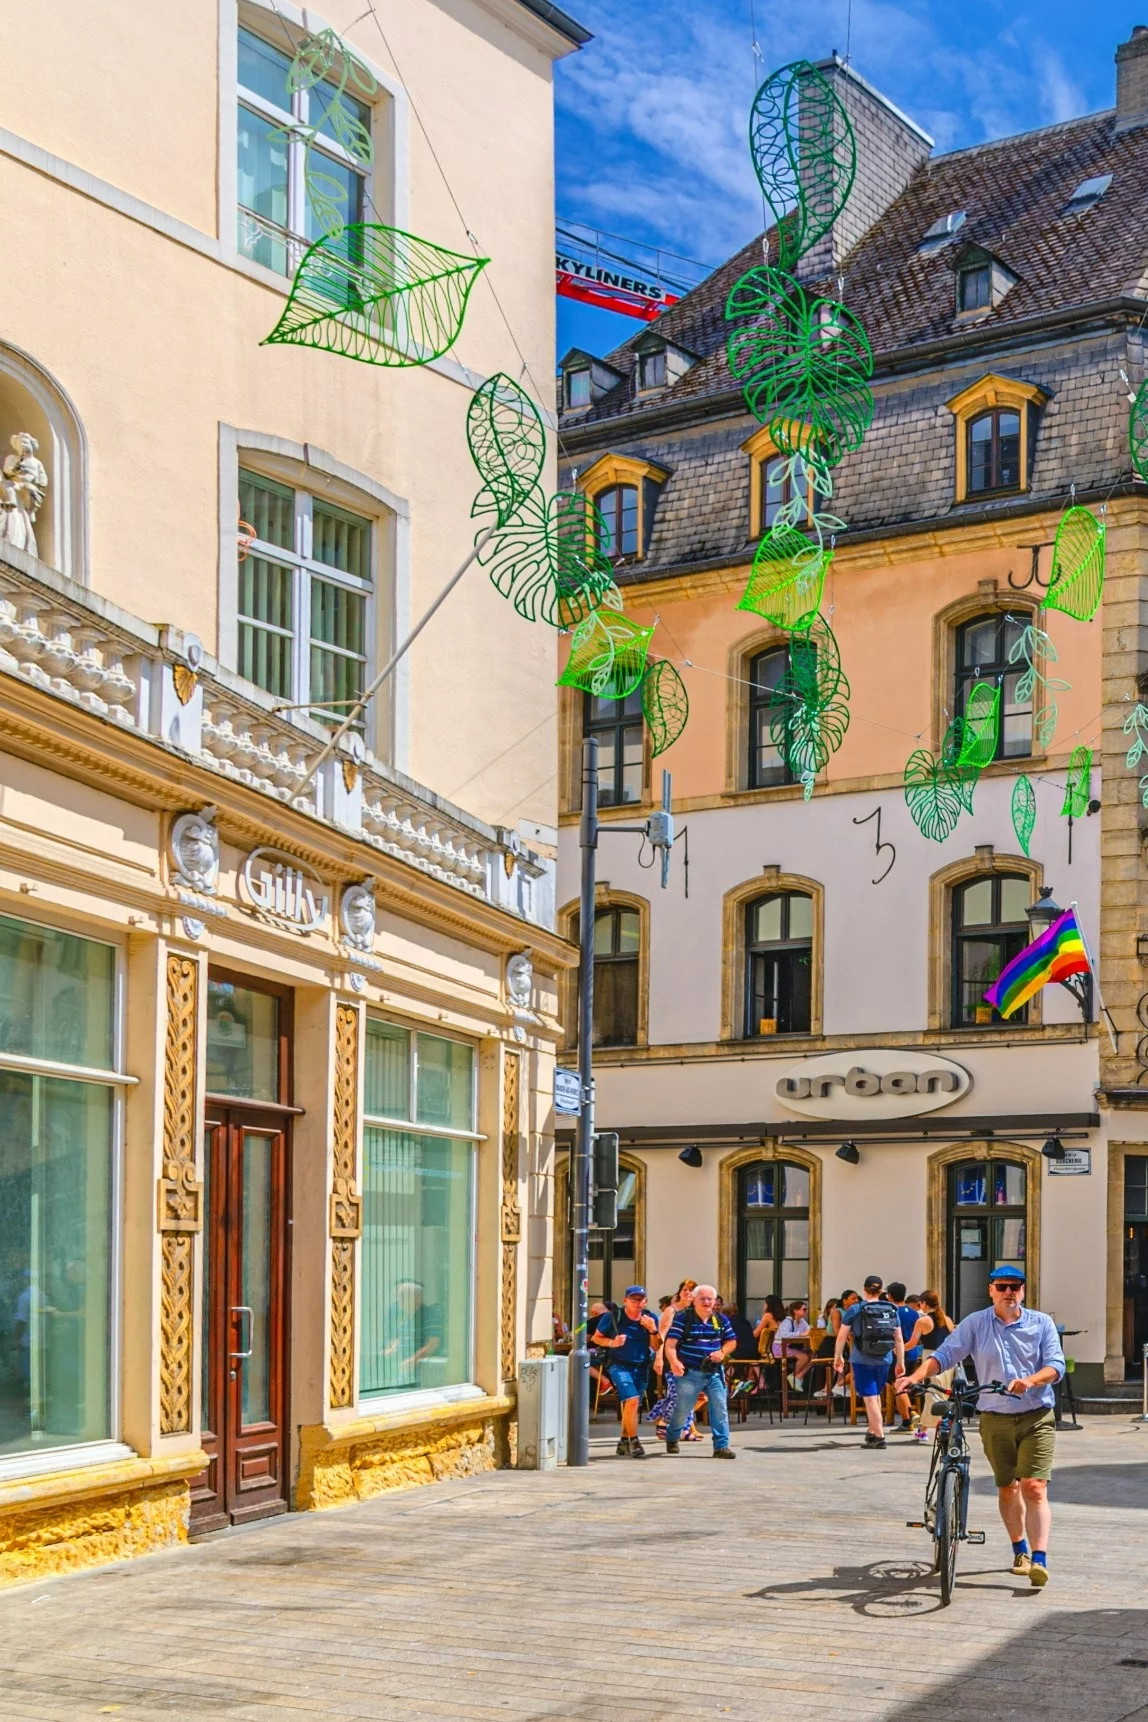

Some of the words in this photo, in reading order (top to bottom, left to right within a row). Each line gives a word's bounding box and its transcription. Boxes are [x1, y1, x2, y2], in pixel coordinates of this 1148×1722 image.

[556, 256, 662, 299] KYLINERS
[245, 846, 328, 931] Gilly
[776, 1066, 959, 1100] urban
